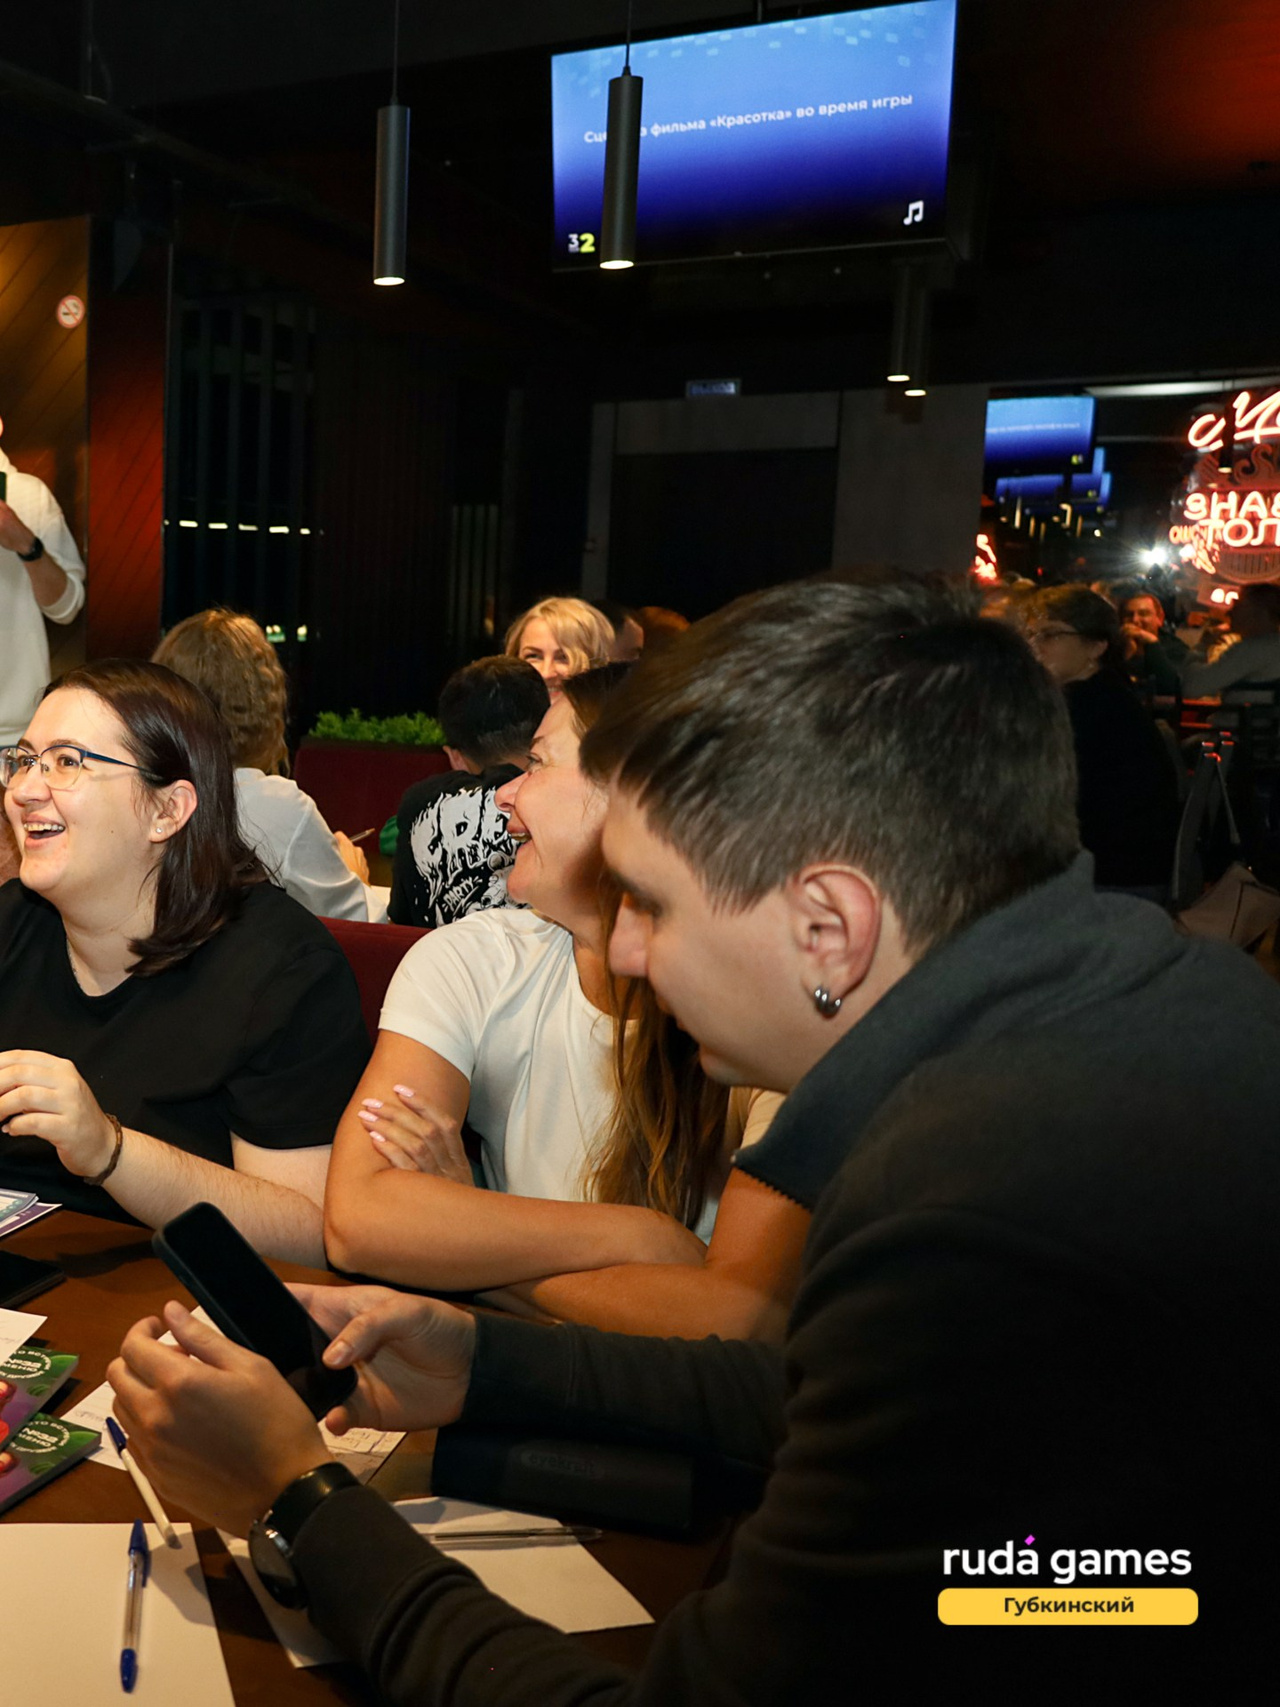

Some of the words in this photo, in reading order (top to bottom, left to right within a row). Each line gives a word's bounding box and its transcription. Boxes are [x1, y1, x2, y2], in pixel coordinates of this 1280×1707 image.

[650, 117, 706, 139] фильма
[709, 108, 792, 130] «Красотка»
[796, 105, 815, 119] во
[818, 100, 869, 119] время
[872, 93, 913, 113] игры
